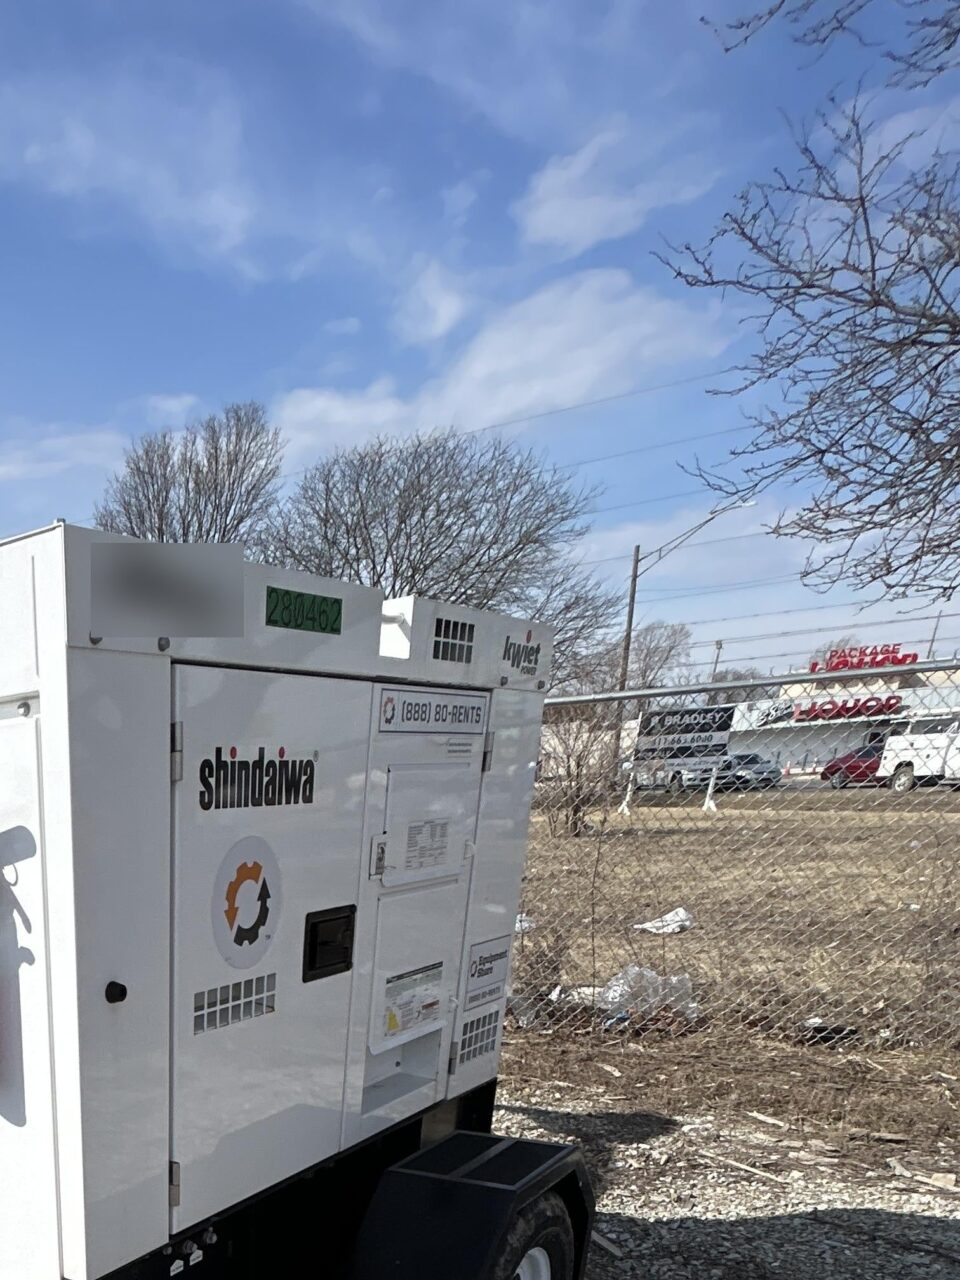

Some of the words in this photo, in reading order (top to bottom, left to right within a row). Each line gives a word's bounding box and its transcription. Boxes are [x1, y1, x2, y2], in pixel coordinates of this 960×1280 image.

[268, 589, 340, 632] 280462
[828, 643, 902, 660] PACKAGE
[401, 700, 432, 723] (888)
[434, 704, 482, 724] 80-RENTS
[665, 711, 725, 725] BRADLEY
[793, 695, 903, 721] LIQUOR
[199, 746, 314, 811] shindaiwa
